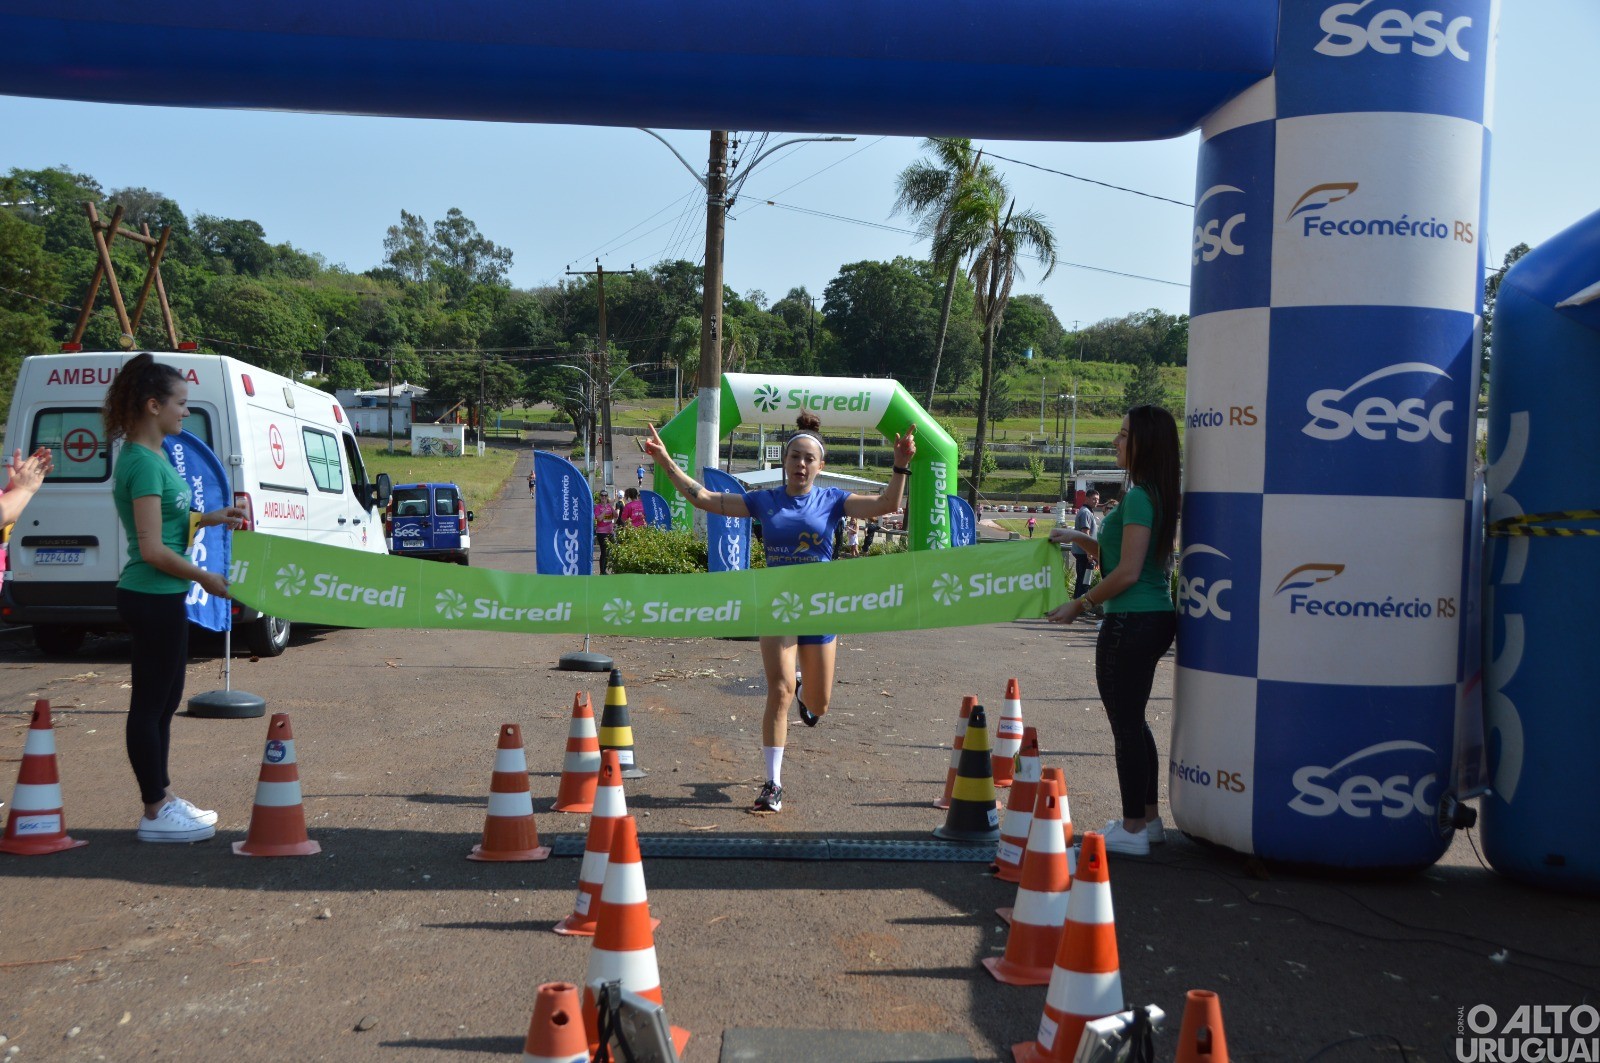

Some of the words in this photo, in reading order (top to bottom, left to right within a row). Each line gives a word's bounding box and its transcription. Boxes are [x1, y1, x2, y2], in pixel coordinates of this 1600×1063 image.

[1313, 2, 1473, 62] Sesc
[1303, 214, 1448, 239] Fecomércio
[1454, 220, 1474, 244] RS
[46, 367, 200, 386] AMBUA
[786, 389, 871, 412] Sicredi
[1229, 405, 1258, 426] RS
[1300, 387, 1454, 444] Sesc
[670, 453, 689, 520] Sicdi
[930, 461, 947, 527] Sicredi
[263, 499, 306, 521] AMBULÂNCIA
[394, 528, 421, 537] Sesc
[309, 573, 407, 609] Sicredi
[968, 565, 1052, 598] Sicredi
[472, 597, 573, 622] Sicredi
[641, 600, 742, 623] Sicredi
[808, 583, 904, 616] Sicredi
[1290, 594, 1432, 618] Fecomércio
[1437, 597, 1456, 618] RS
[1217, 769, 1246, 793] RS
[1287, 765, 1437, 819] Sesc
